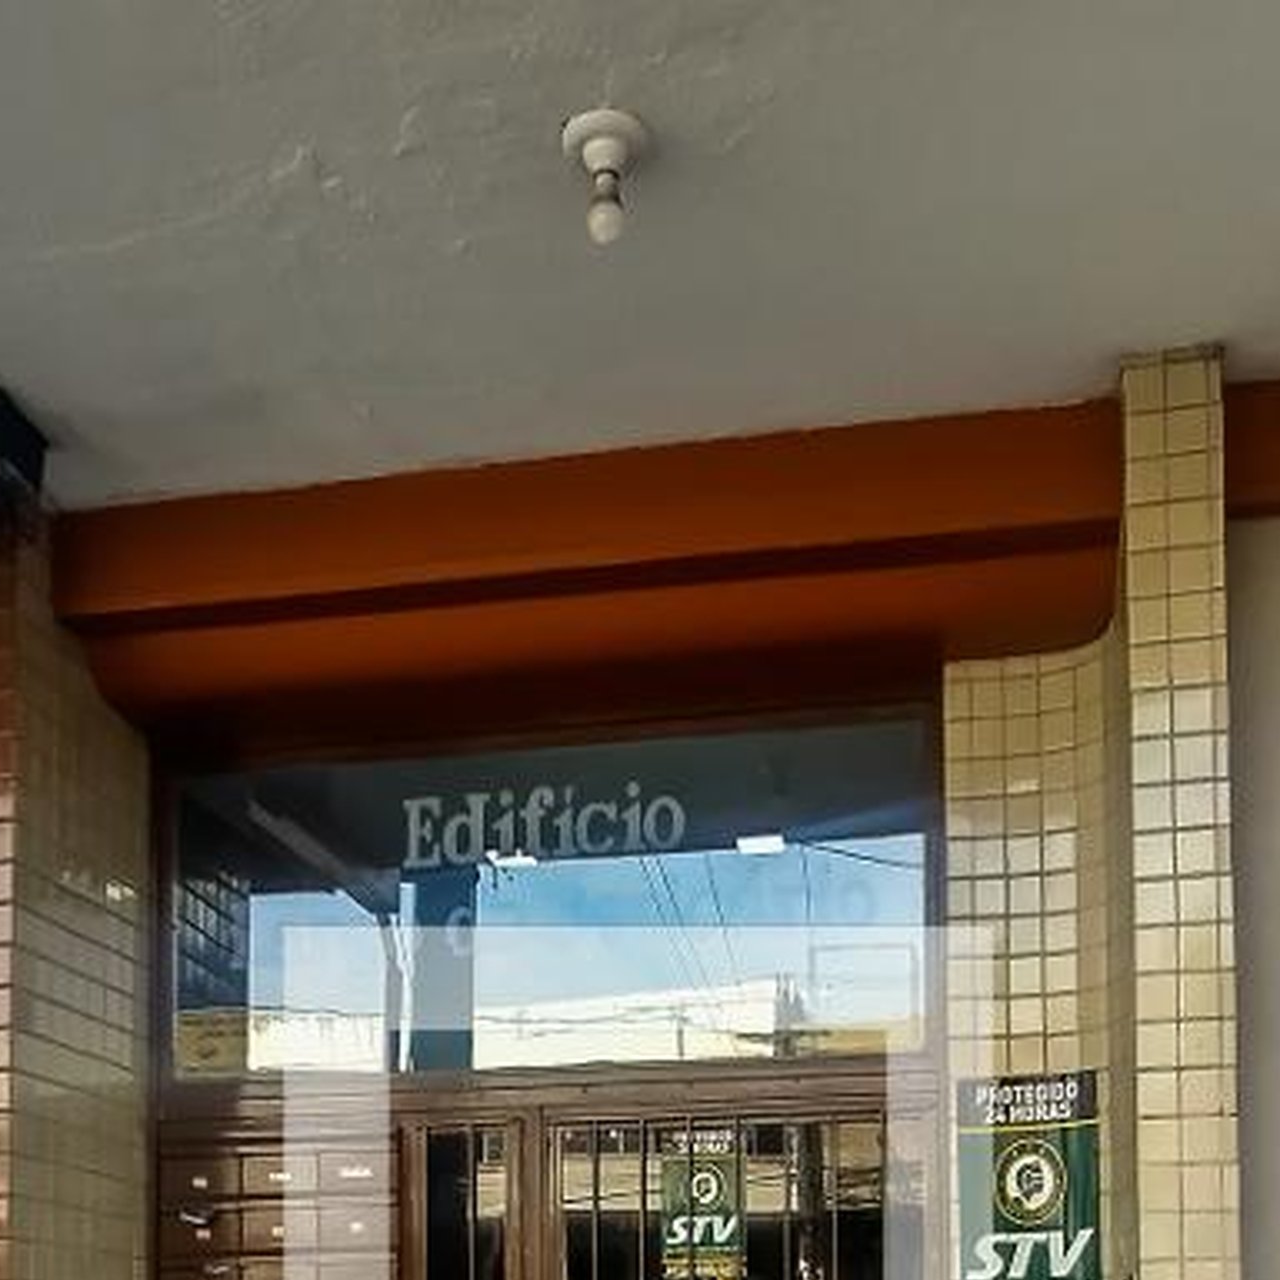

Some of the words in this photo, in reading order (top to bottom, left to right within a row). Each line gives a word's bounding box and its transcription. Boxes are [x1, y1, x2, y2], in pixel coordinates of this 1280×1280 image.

[403, 780, 687, 868] Edifício
[666, 1214, 738, 1244] STV
[966, 1228, 1094, 1280] STV
